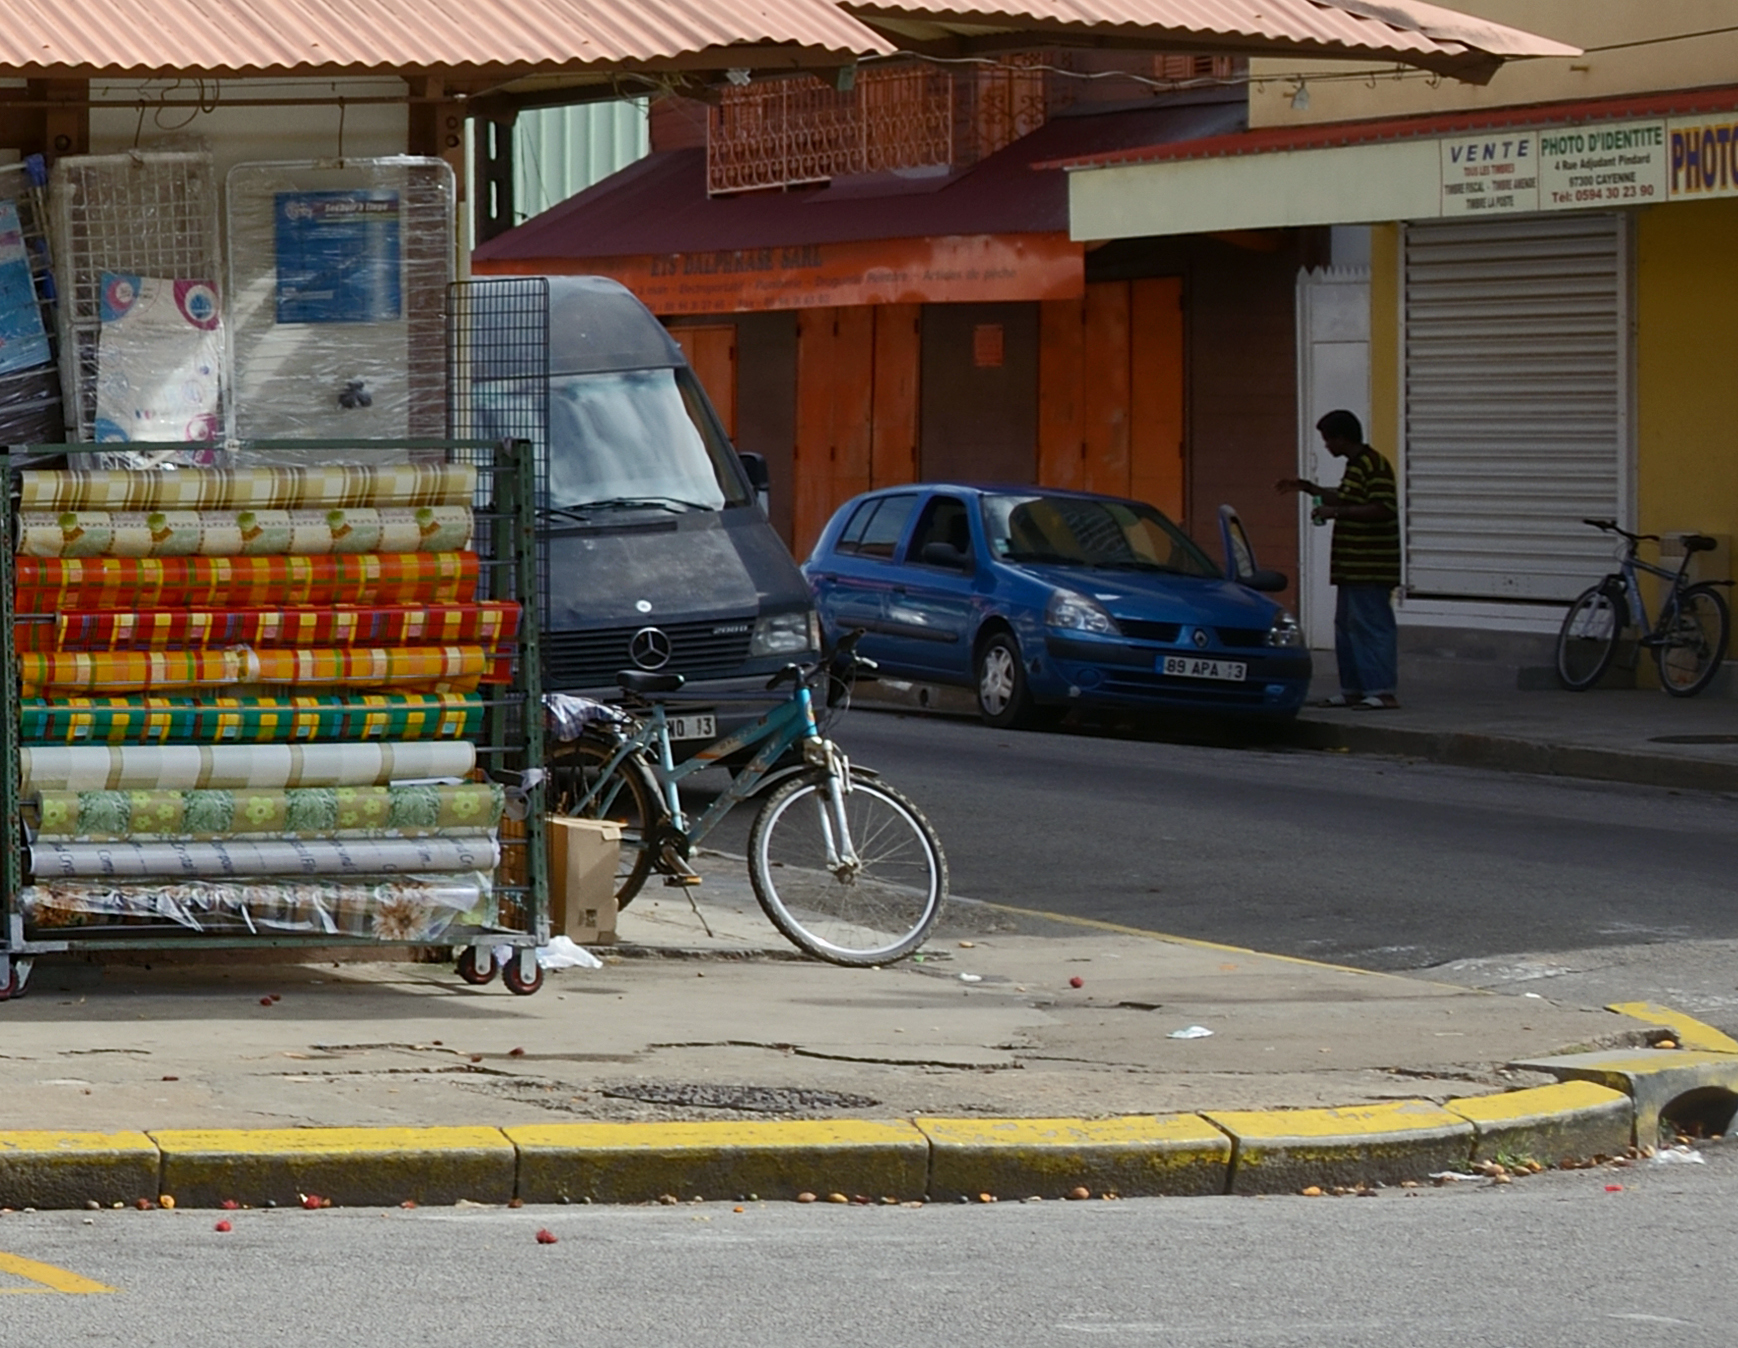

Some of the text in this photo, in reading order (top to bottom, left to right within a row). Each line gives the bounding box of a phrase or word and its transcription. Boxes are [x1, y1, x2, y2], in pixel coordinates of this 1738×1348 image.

[1541, 126, 1663, 156] PHOTO D'IDENTITE
[1451, 139, 1529, 163] VENTE
[1562, 159, 1578, 170] Rue
[1580, 156, 1616, 171] Adjudant
[1595, 171, 1636, 185] CAYENNE
[1575, 188, 1603, 202] 0594
[1605, 186, 1619, 199] 30
[1623, 185, 1637, 198] 23
[1640, 184, 1654, 196] 90
[1166, 658, 1186, 674] 89
[1191, 661, 1219, 677] APA
